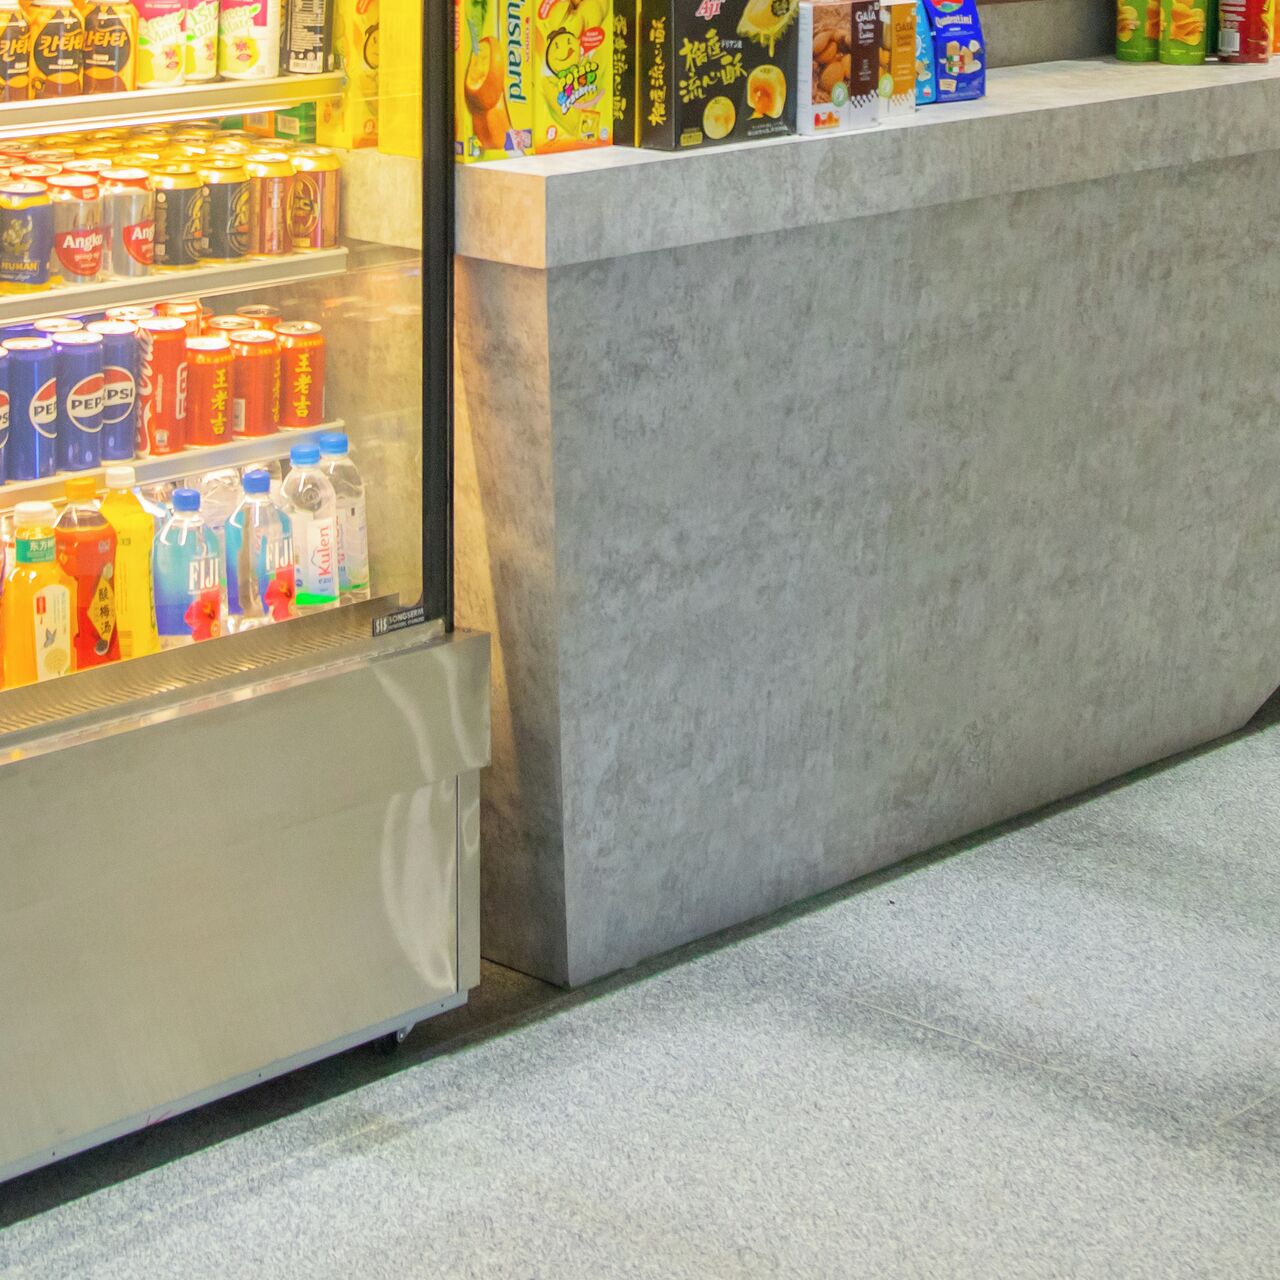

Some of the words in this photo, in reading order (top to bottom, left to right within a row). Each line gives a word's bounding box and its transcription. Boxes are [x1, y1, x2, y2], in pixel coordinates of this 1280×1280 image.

[210, 368, 228, 435] 王老吉
[293, 353, 312, 418] 王老吉
[189, 558, 219, 590] FIJI
[266, 537, 293, 570] FIJI
[319, 526, 330, 576] Kulen
